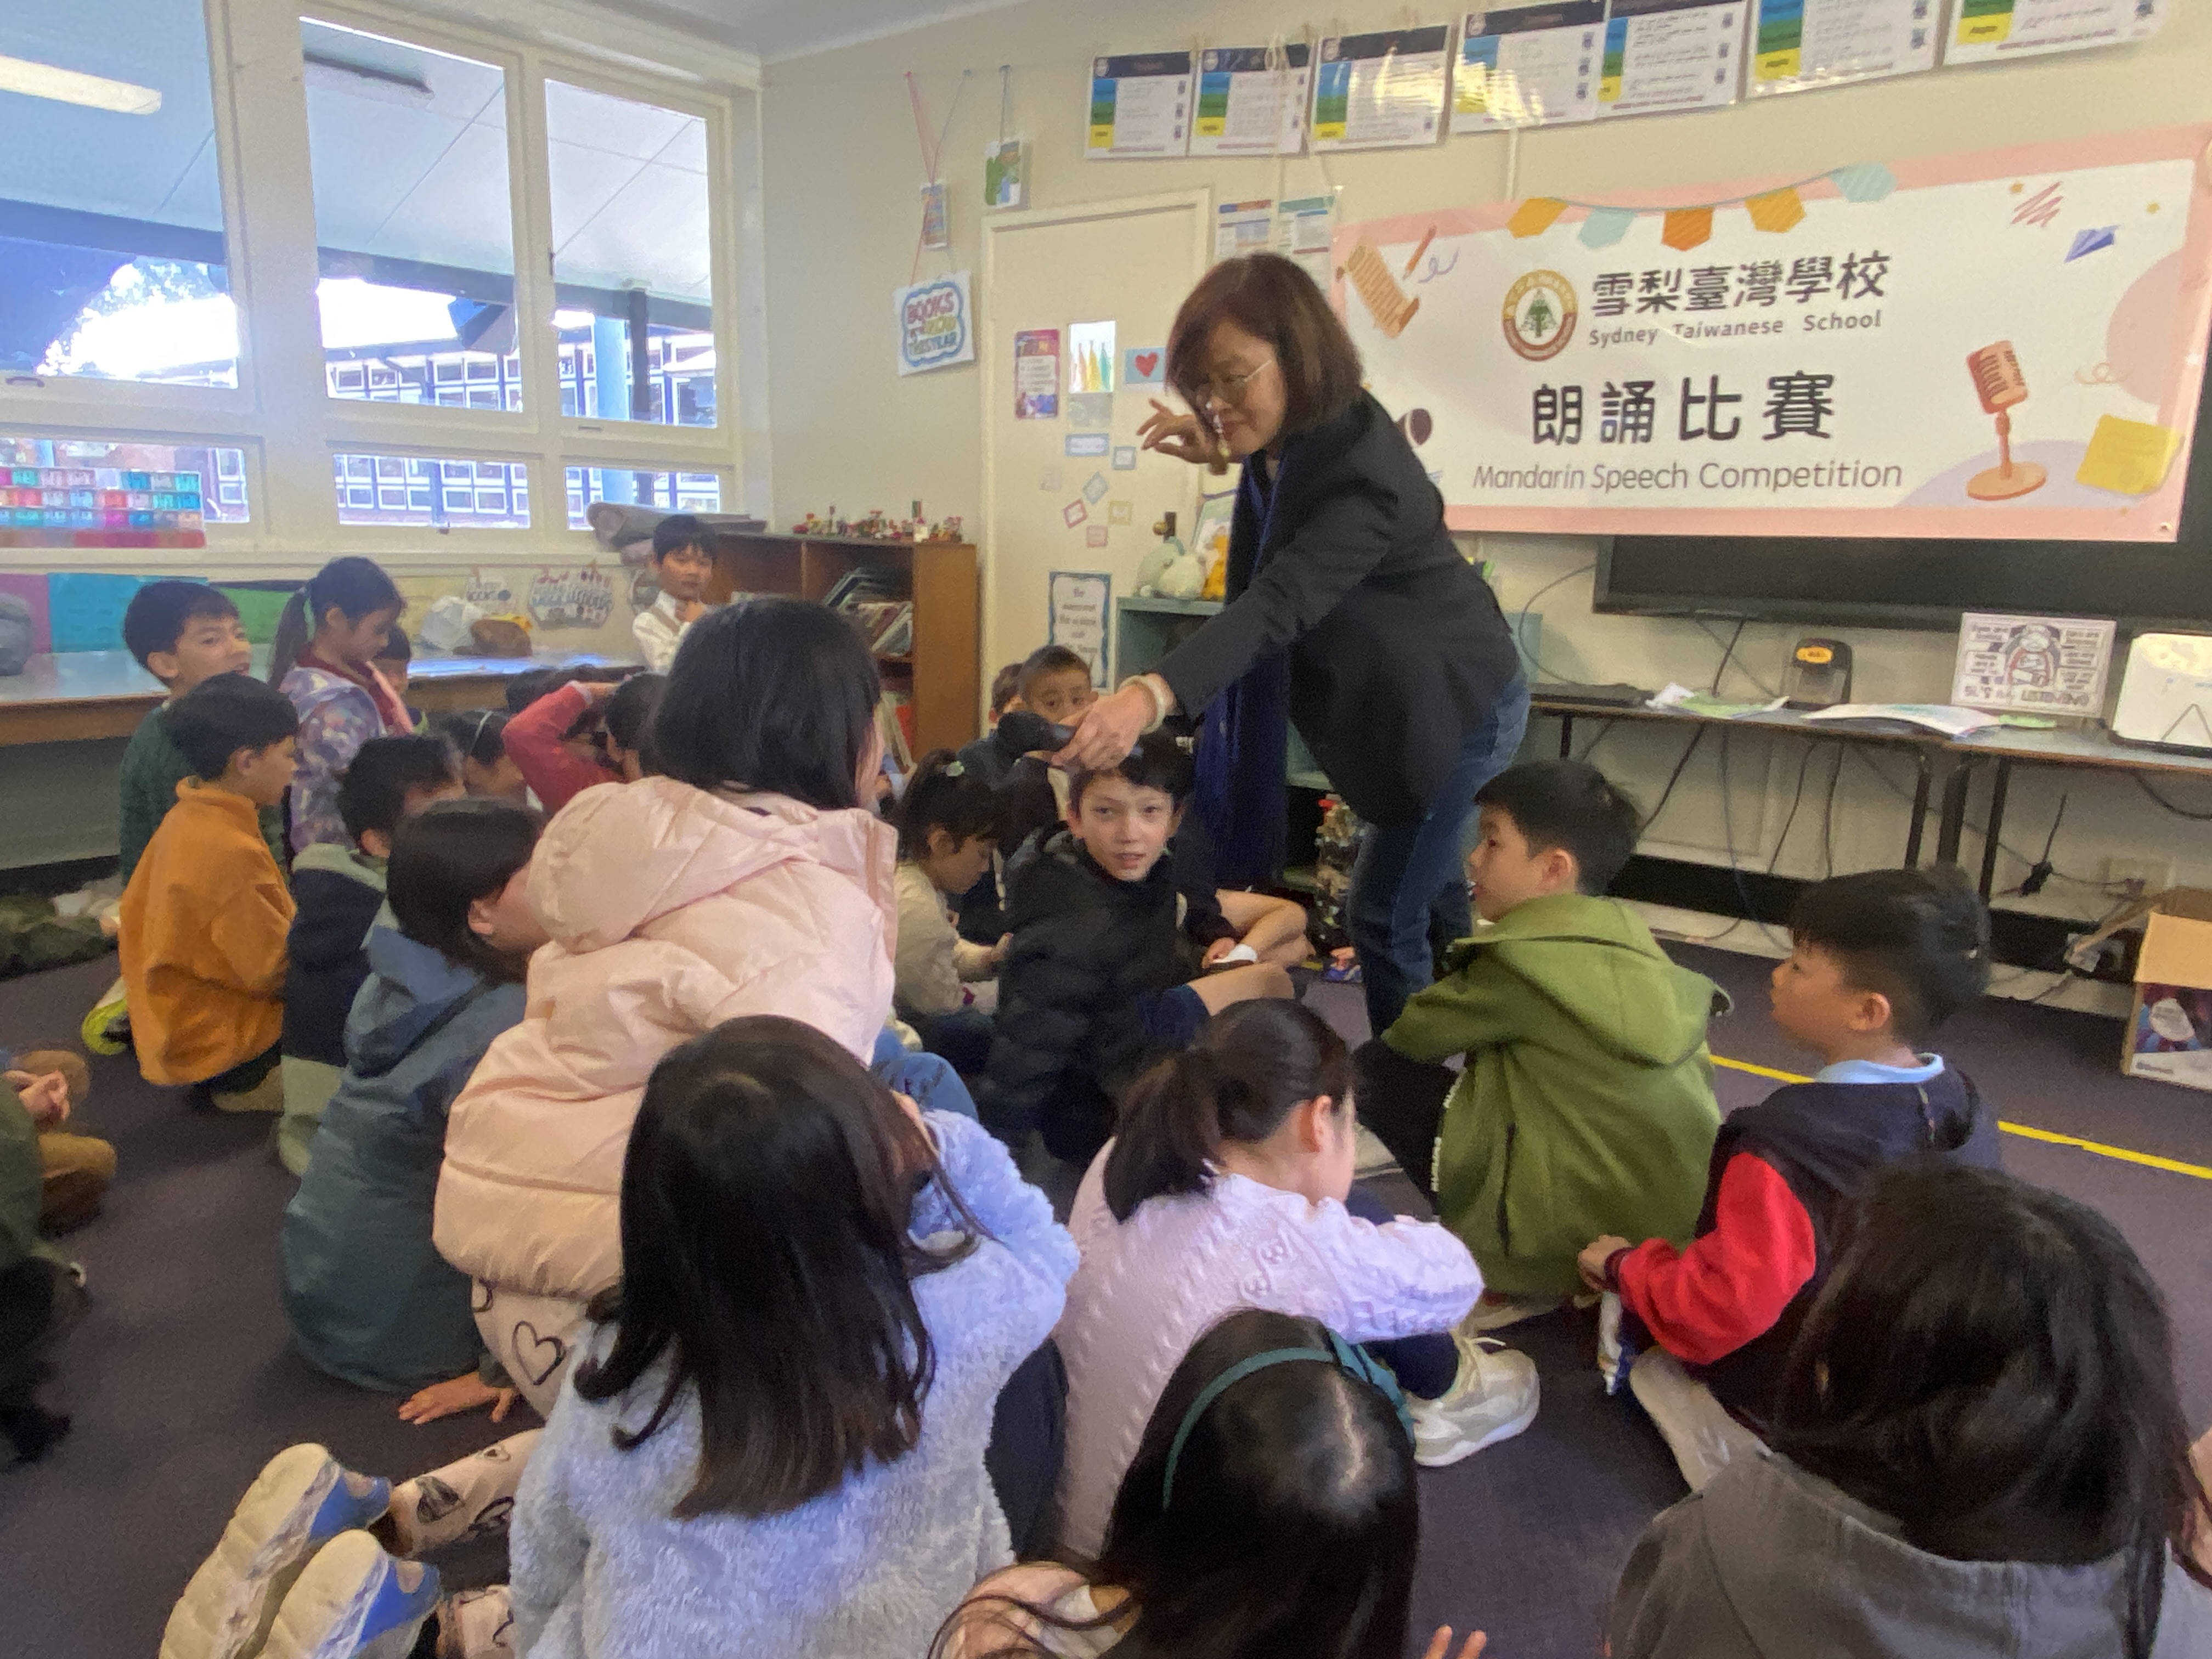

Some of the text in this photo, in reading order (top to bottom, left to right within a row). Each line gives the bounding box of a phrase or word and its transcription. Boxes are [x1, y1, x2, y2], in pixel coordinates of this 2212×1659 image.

[1591, 250, 1891, 318] 雪梨臺灣學校
[1588, 325, 1659, 349] Sydney
[1672, 318, 1784, 339] Taiwanese
[1803, 309, 1882, 332] School
[1532, 370, 1835, 446] 朗誦比賽
[1472, 459, 1902, 494] Mandarin Speech Competition
